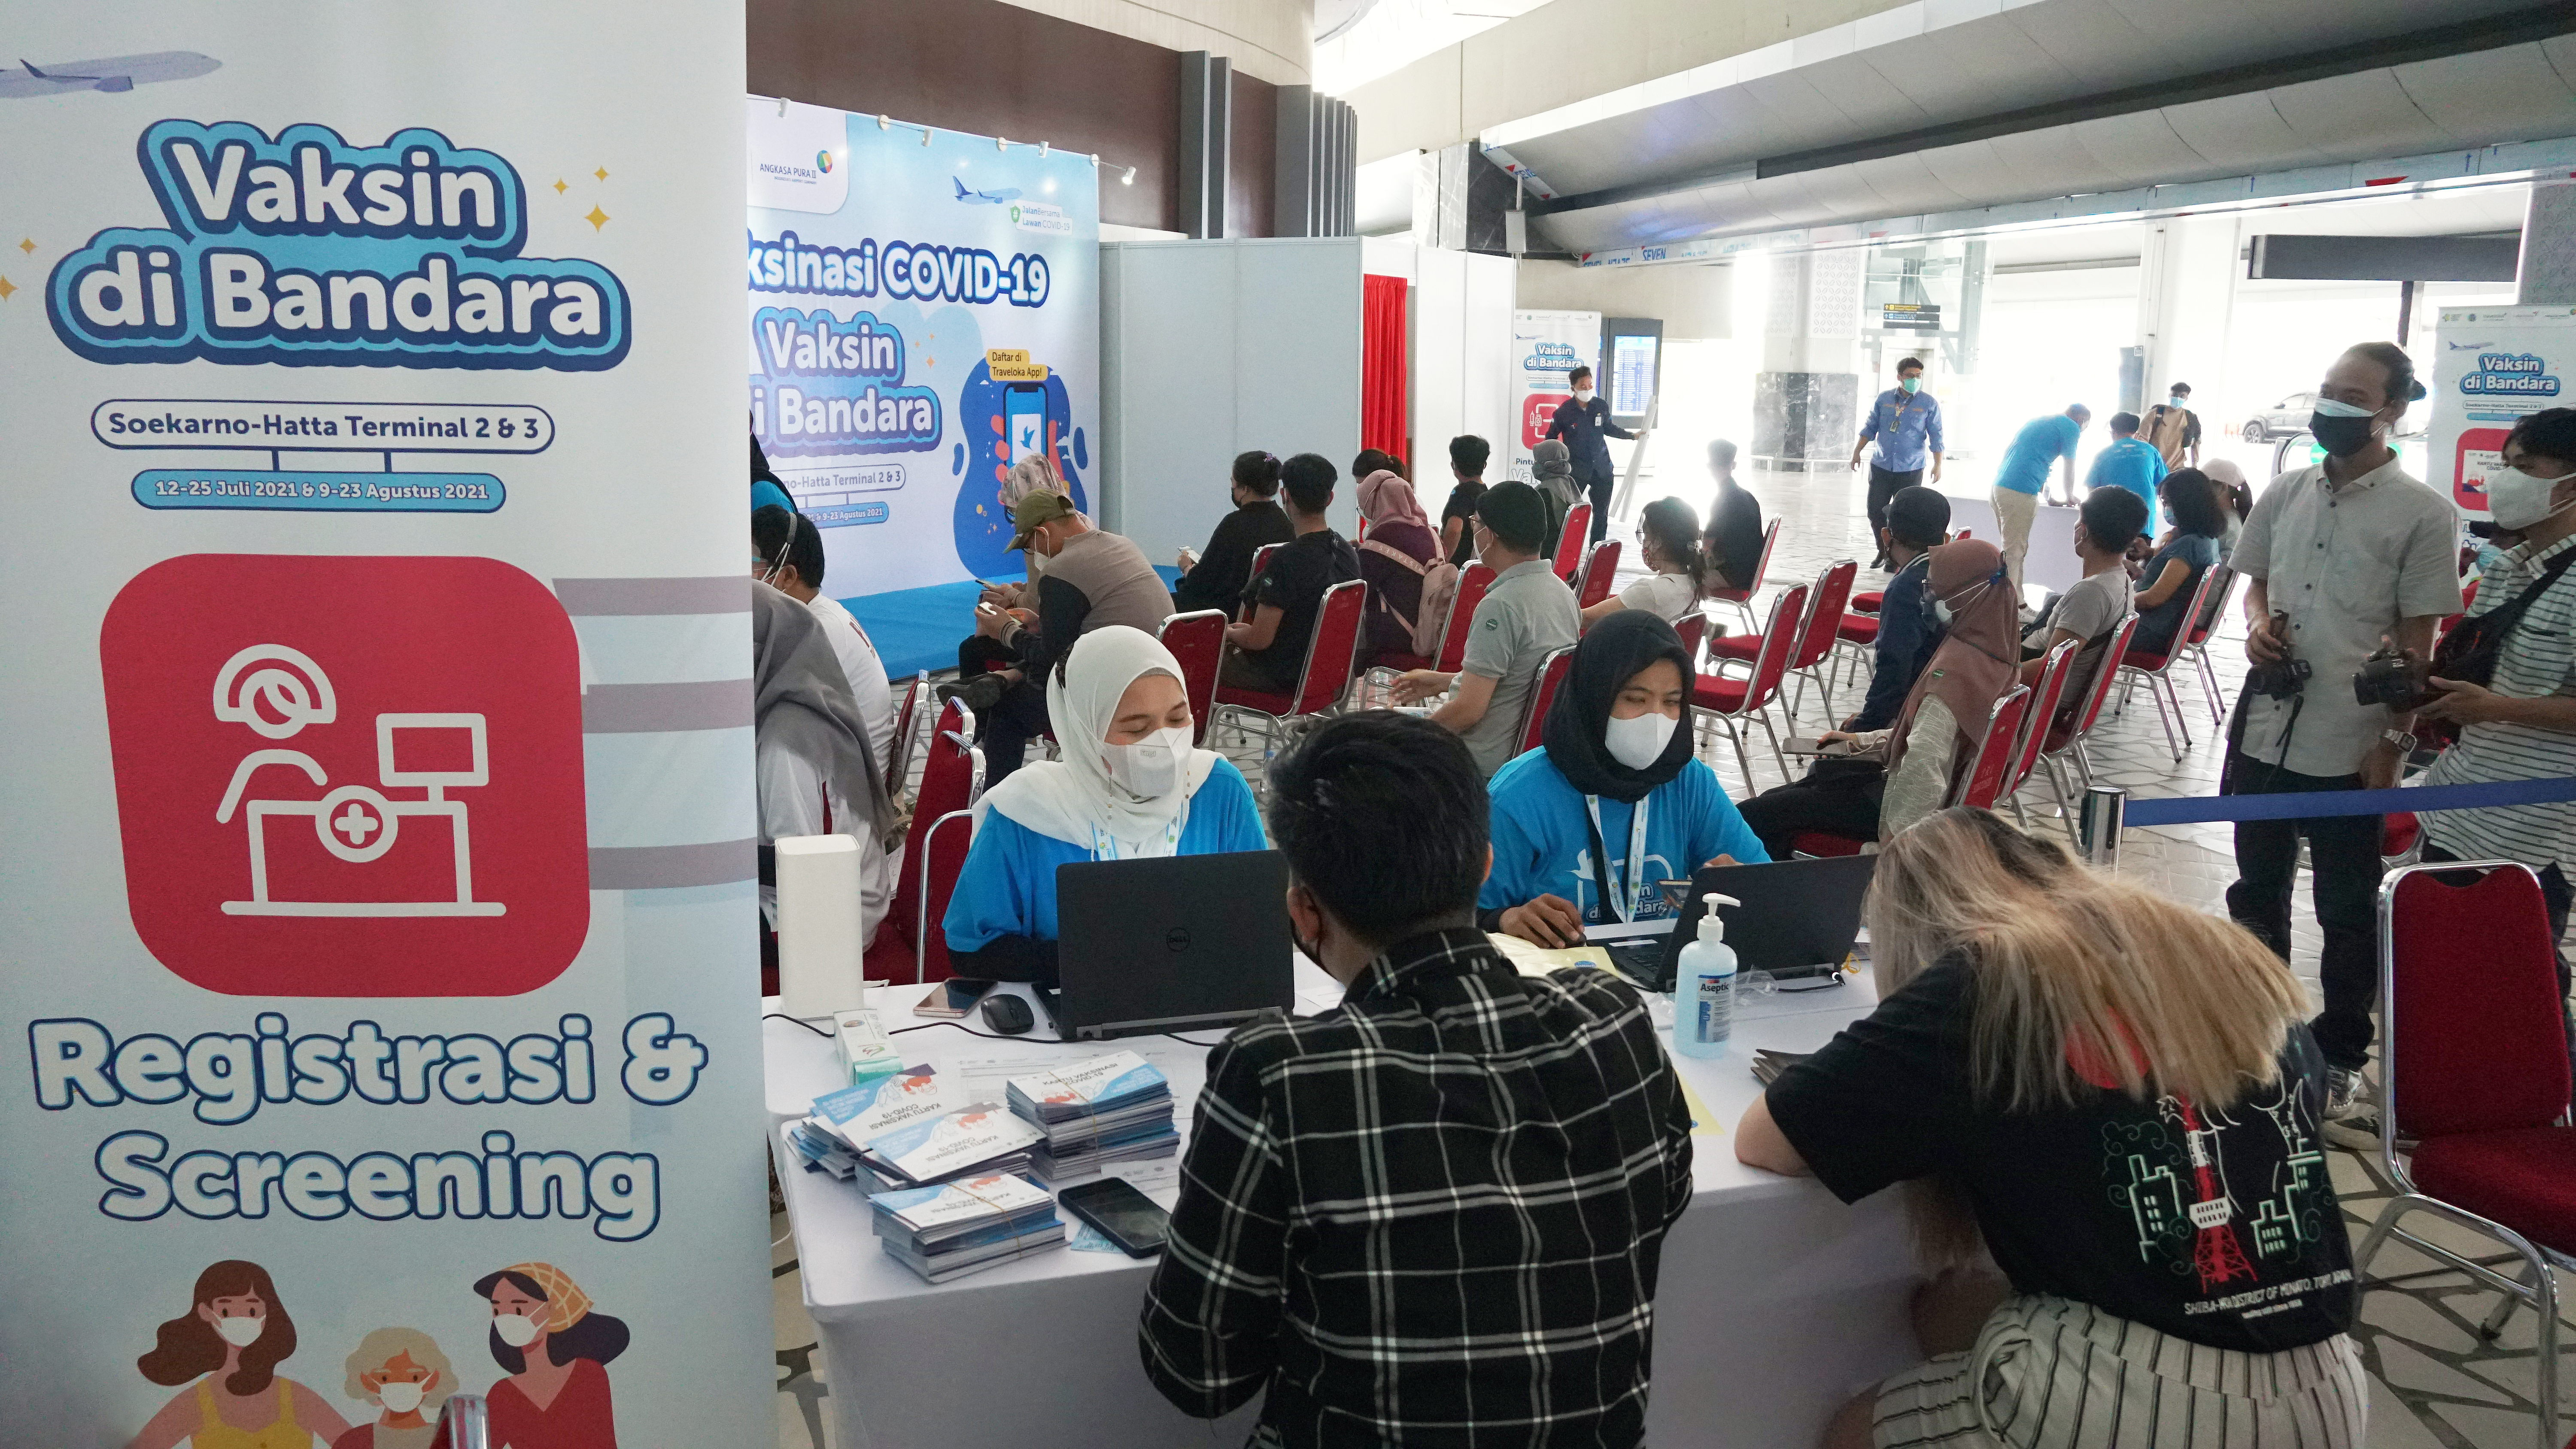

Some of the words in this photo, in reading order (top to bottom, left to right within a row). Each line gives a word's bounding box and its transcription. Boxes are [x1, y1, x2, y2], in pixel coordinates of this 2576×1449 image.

[760, 164, 792, 176] ANGKASA
[794, 168, 811, 178] PURA
[171, 142, 496, 228] Vaksin
[1023, 218, 1041, 227] Lawan
[1042, 220, 1070, 230] COVID-19
[1642, 247, 1666, 261] SEVEN
[884, 246, 1047, 303] COVID-19
[79, 249, 175, 328] di
[208, 252, 602, 335] Bandara
[766, 321, 895, 370] Vaksin
[1537, 344, 1572, 355] Vaksin
[992, 351, 1014, 363] Daftar
[1015, 352, 1022, 362] di
[1527, 357, 1537, 367] di
[1540, 358, 1582, 368] Bandara
[2483, 356, 2539, 371] Vaksin
[992, 367, 1025, 377] Traveloka
[1027, 367, 1042, 379] App!
[2464, 375, 2481, 389] di
[2485, 375, 2555, 390] Bandara
[750, 391, 764, 436] i
[779, 388, 931, 435] Bandara
[109, 412, 338, 438] Soekarno-Hatta
[346, 416, 468, 439] Terminal
[475, 418, 490, 439] 2
[497, 419, 518, 440] &
[523, 419, 539, 440] 3
[833, 473, 875, 485] Terminal
[879, 472, 884, 482] 2
[887, 472, 893, 482] &
[895, 471, 901, 482] 3
[156, 480, 213, 497] 12-25
[217, 480, 250, 499] Juli
[254, 481, 298, 498] 2021
[302, 481, 314, 498] &
[318, 482, 362, 499] 9-23
[366, 482, 441, 503] Agustus
[445, 483, 488, 500] 2021
[822, 511, 838, 521] 9-23
[839, 510, 866, 521] Agustus
[867, 507, 883, 516] 2021
[1701, 983, 1729, 994] Aseptic
[29, 1012, 596, 1125] Registrasi
[622, 1012, 708, 1106] &
[1042, 1075, 1072, 1085] KARTU
[1072, 1063, 1118, 1079] VAKSINASI
[882, 1103, 919, 1119] COVID-19
[913, 1102, 941, 1115] KARTU
[868, 1112, 913, 1130] VAKSINASI
[95, 1130, 660, 1242] Screening
